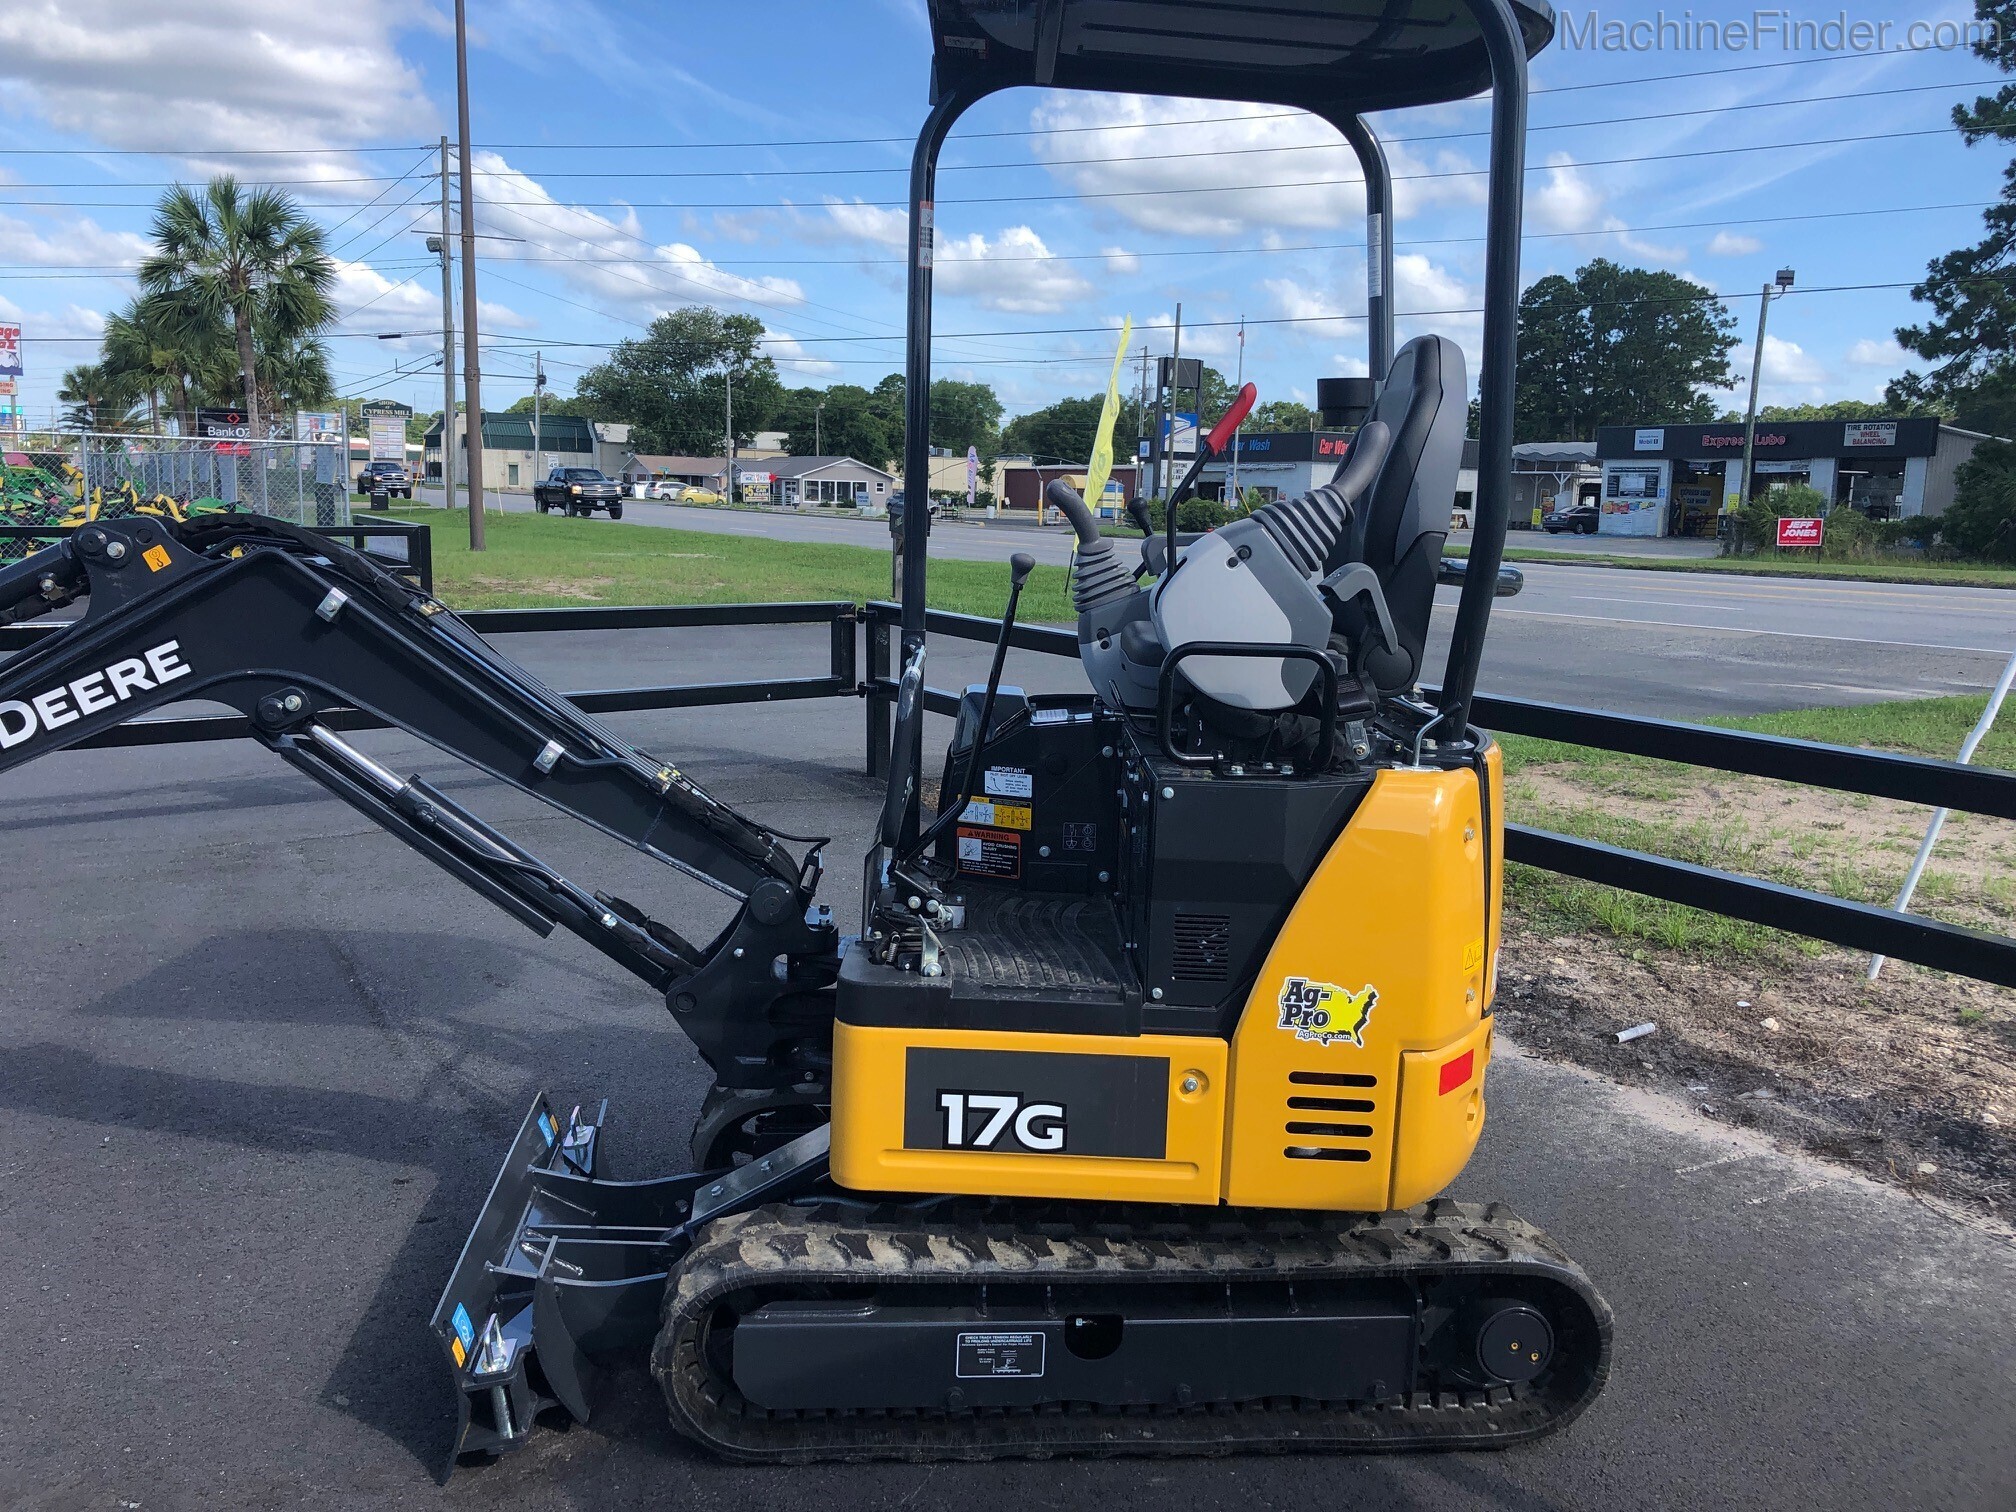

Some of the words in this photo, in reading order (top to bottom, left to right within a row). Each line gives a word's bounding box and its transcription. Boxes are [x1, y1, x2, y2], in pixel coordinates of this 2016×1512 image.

[207, 426, 234, 437] Bank
[1249, 439, 1270, 451] Wash
[1319, 439, 1333, 454] Car
[1701, 434, 1746, 449] Expres
[1754, 433, 1786, 446] Lube
[1782, 529, 1817, 537] JONES
[0, 639, 192, 749] DEERE
[990, 765, 1026, 774] IMPORTANT
[974, 830, 1010, 840] WARNING
[1283, 981, 1332, 1009] Ag-
[1282, 1004, 1329, 1027] Pro
[1298, 1030, 1351, 1041] AgProCo.com
[940, 1093, 1065, 1151] 17G
